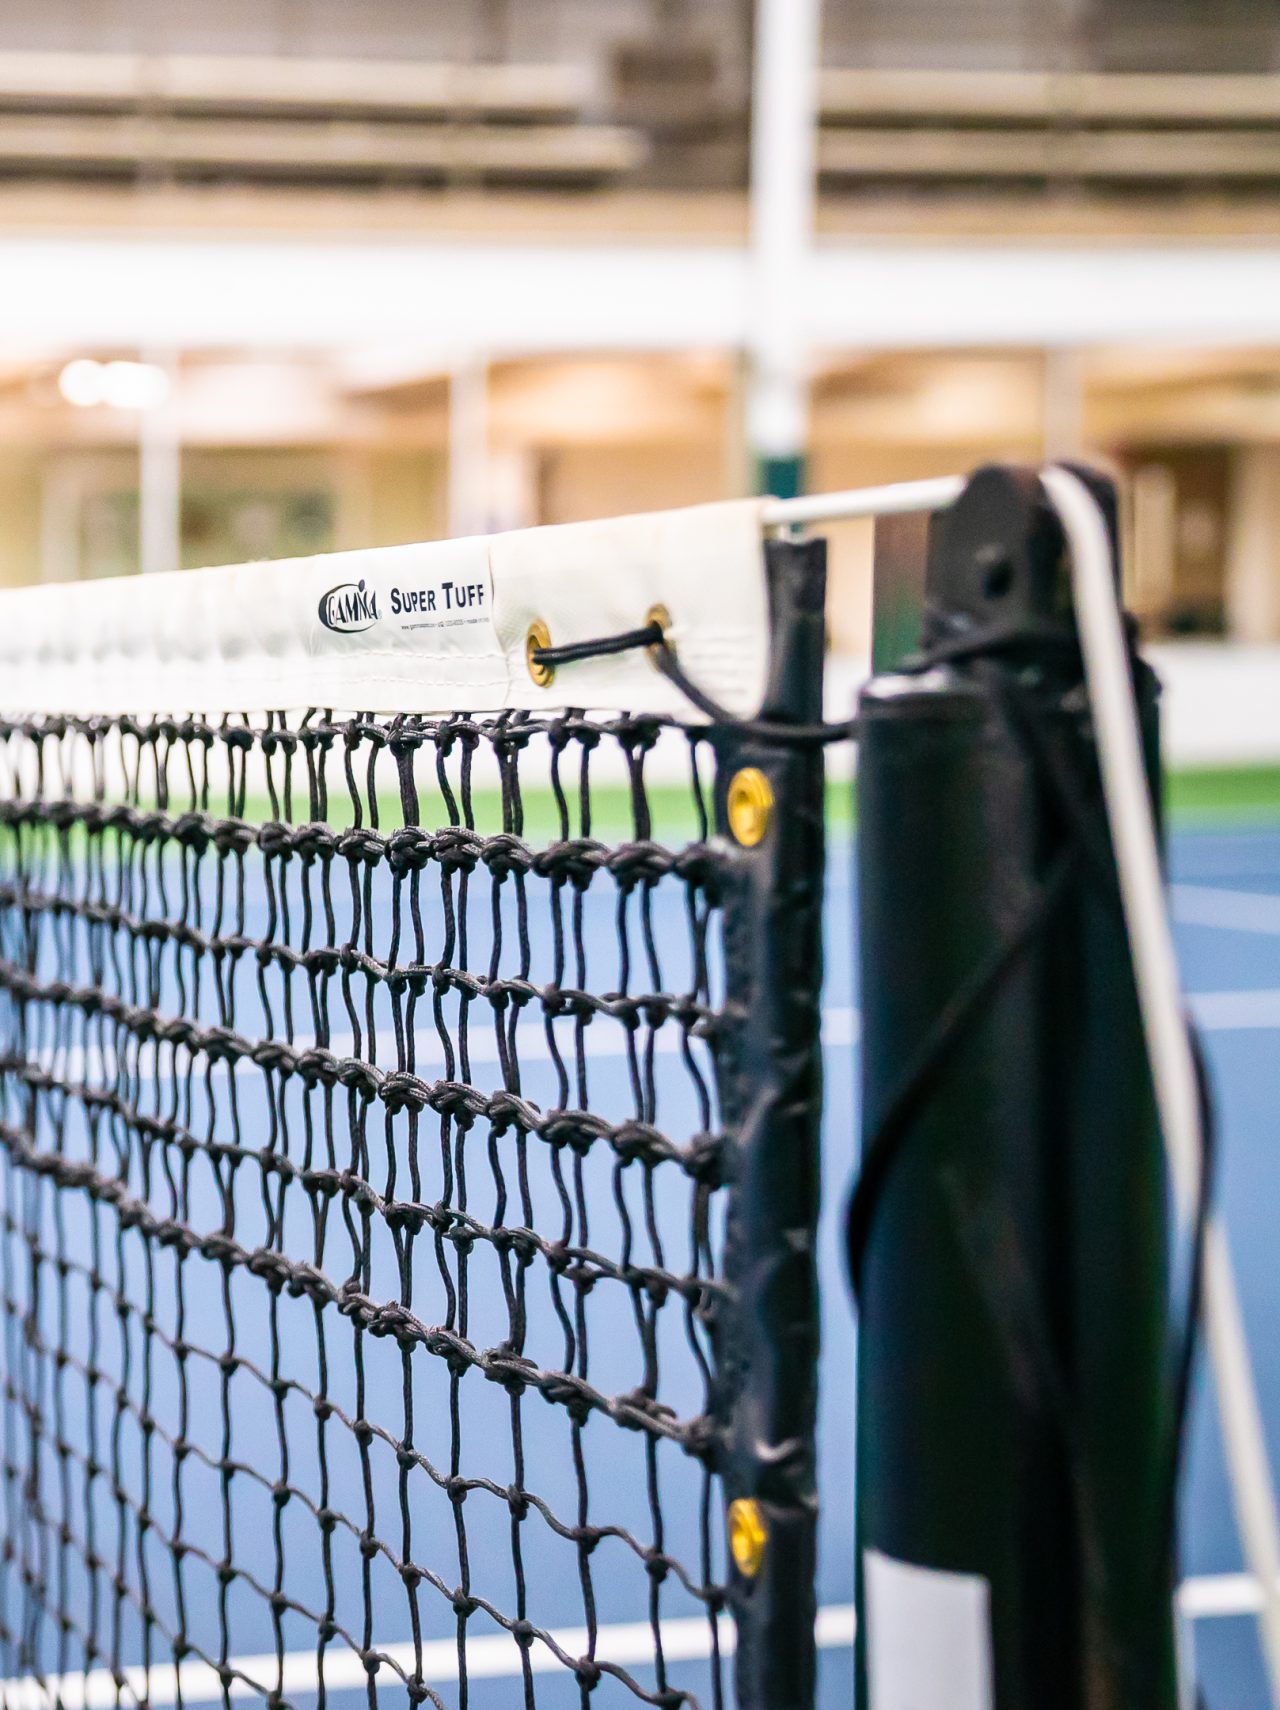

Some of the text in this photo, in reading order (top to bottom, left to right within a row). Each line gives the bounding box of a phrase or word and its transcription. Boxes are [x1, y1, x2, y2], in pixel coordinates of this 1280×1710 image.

[325, 587, 378, 627] GAMMA
[390, 587, 436, 614] SUPER
[442, 582, 485, 610] TUFF
